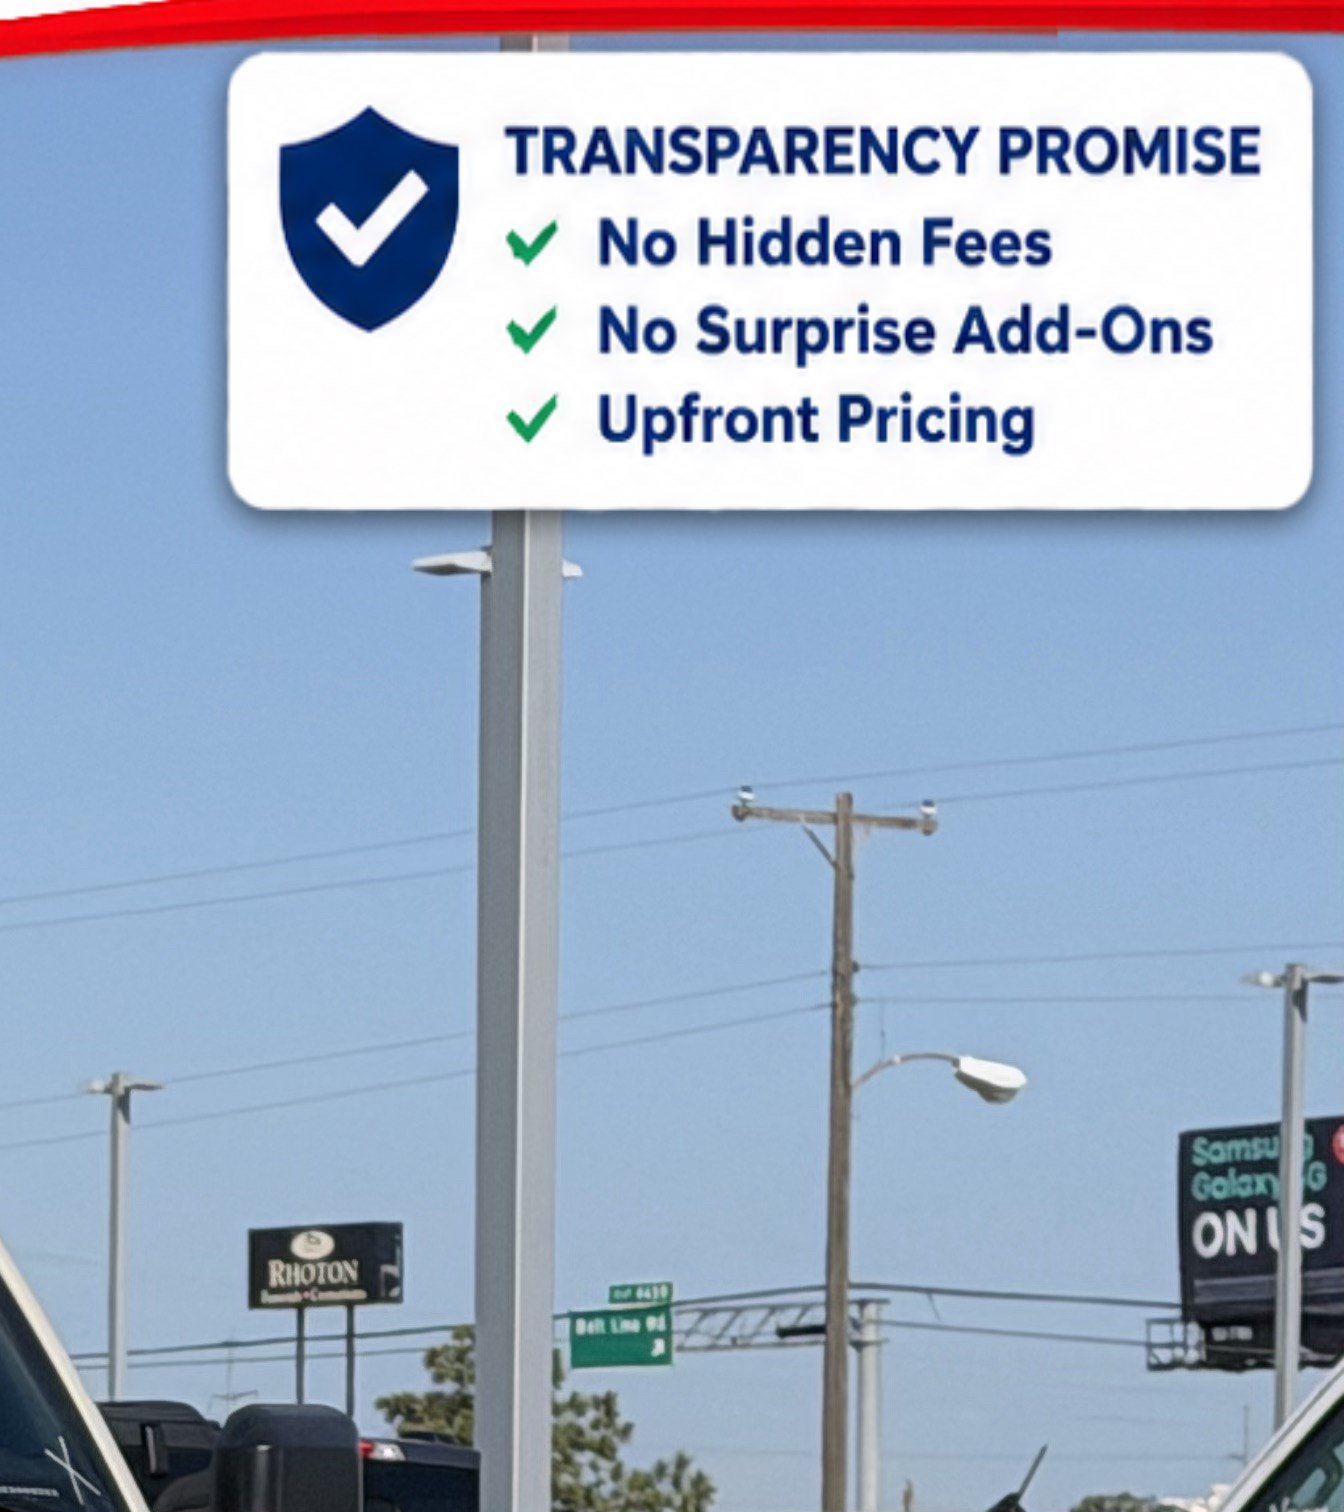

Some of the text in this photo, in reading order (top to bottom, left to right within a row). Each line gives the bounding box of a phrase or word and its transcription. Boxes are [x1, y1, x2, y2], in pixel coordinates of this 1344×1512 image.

[1192, 1134, 1314, 1166] Samsug
[1192, 1207, 1257, 1259] ON
[268, 1258, 360, 1289] RHOTON
